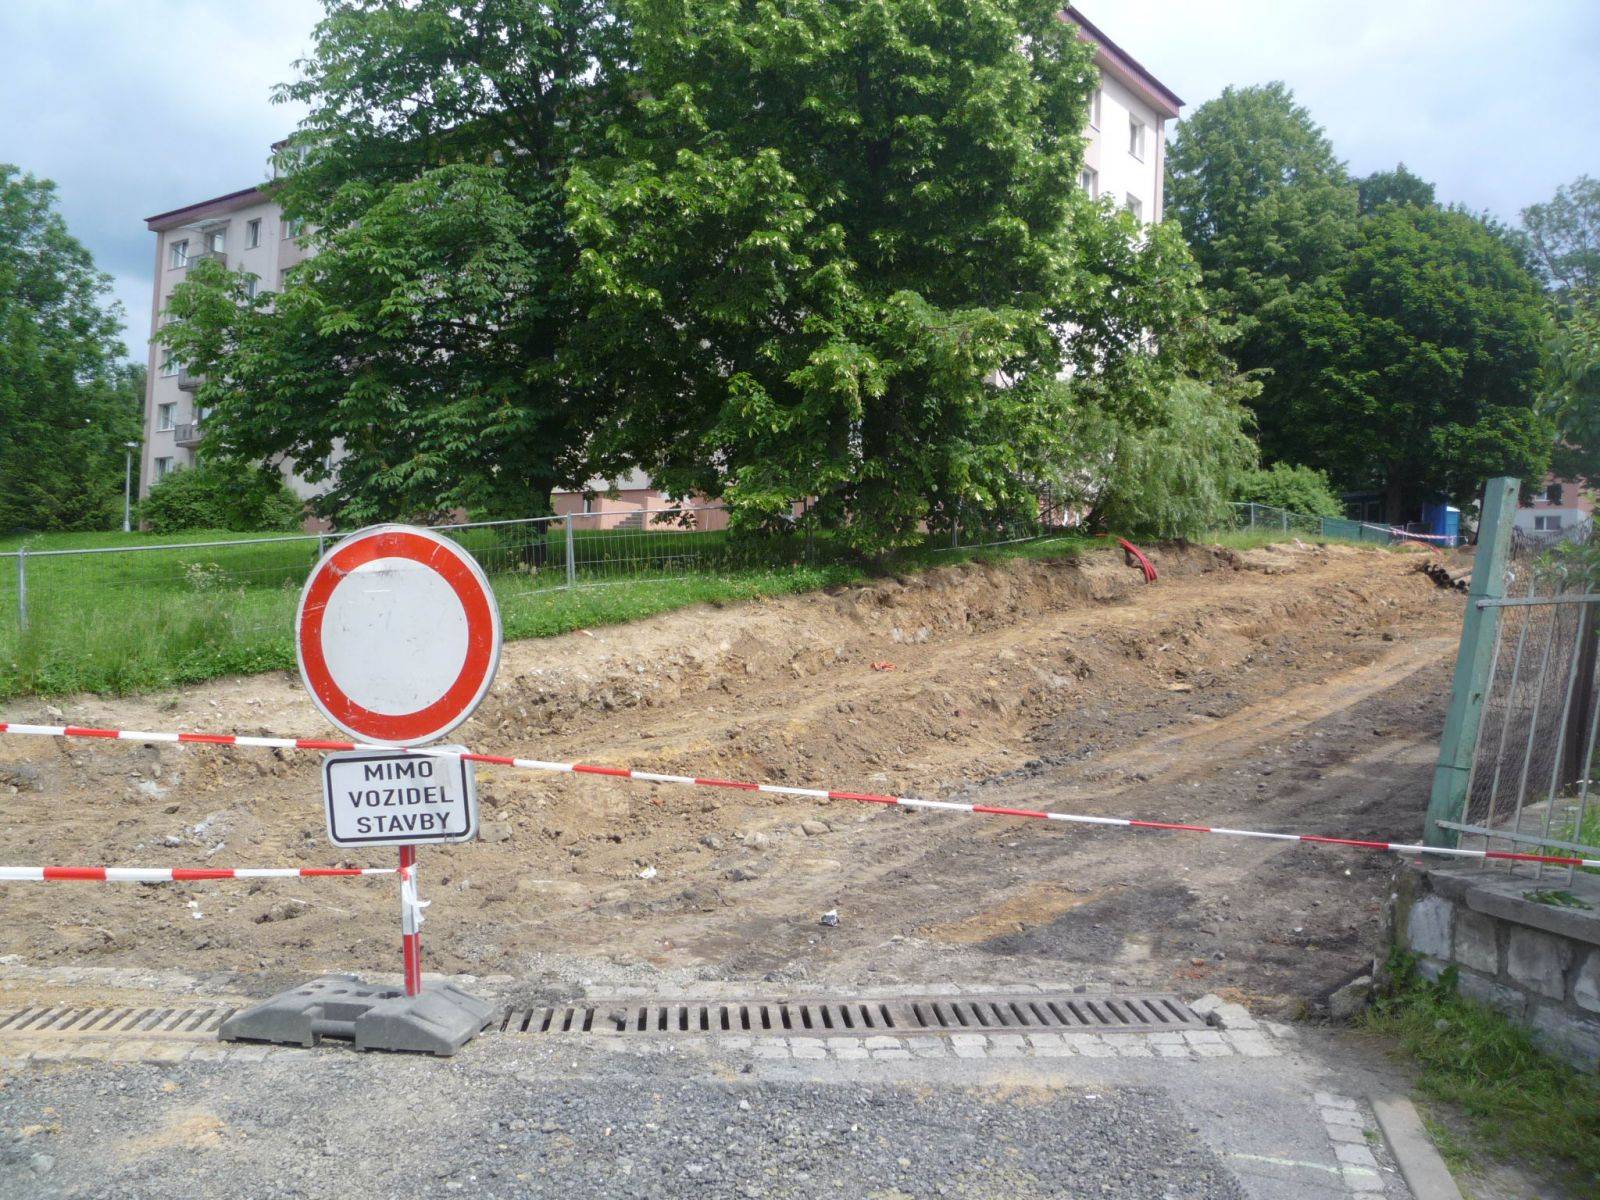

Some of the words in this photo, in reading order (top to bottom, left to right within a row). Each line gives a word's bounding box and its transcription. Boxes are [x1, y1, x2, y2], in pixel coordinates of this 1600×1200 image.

[364, 760, 434, 782] MIMO
[348, 785, 454, 808] VOZIDEL
[356, 811, 450, 834] STAVBY
